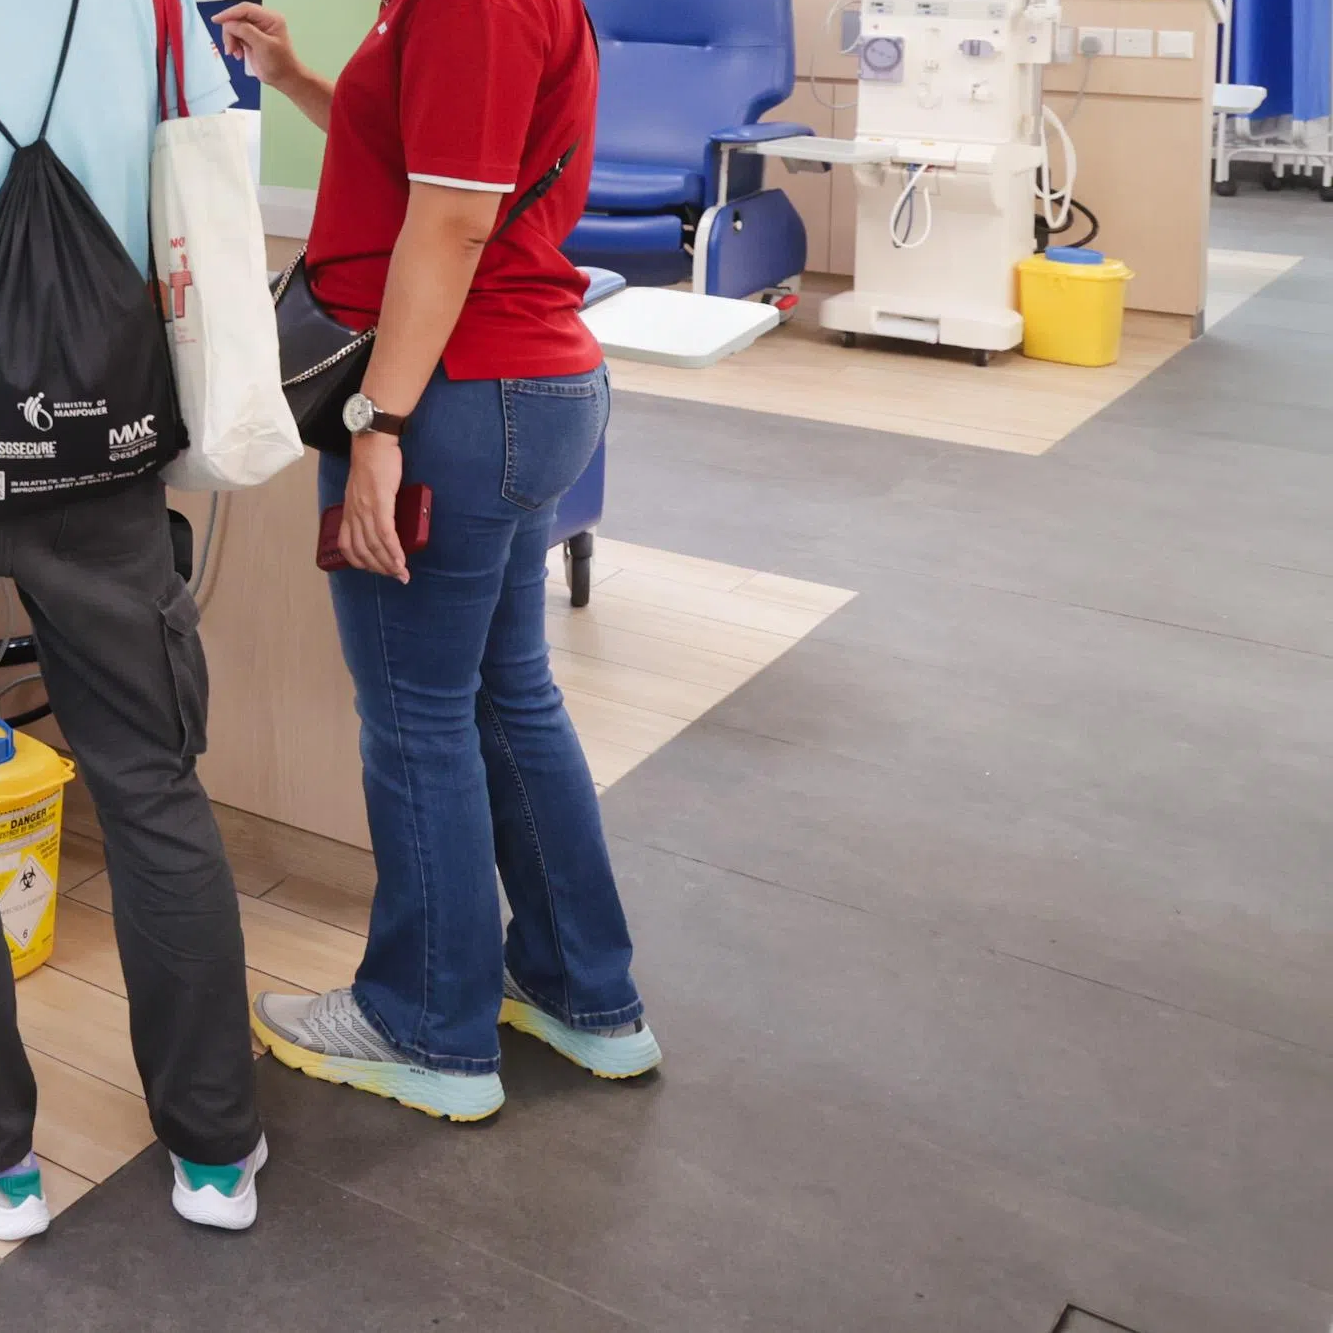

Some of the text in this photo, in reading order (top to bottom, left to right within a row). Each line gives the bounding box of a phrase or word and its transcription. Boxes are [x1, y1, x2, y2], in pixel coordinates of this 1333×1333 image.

[53, 398, 106, 409] MINISTRY OF
[54, 406, 108, 417] MANPOWER
[109, 414, 156, 445] MWC
[10, 808, 46, 829] DANGER
[22, 929, 29, 939] 6
